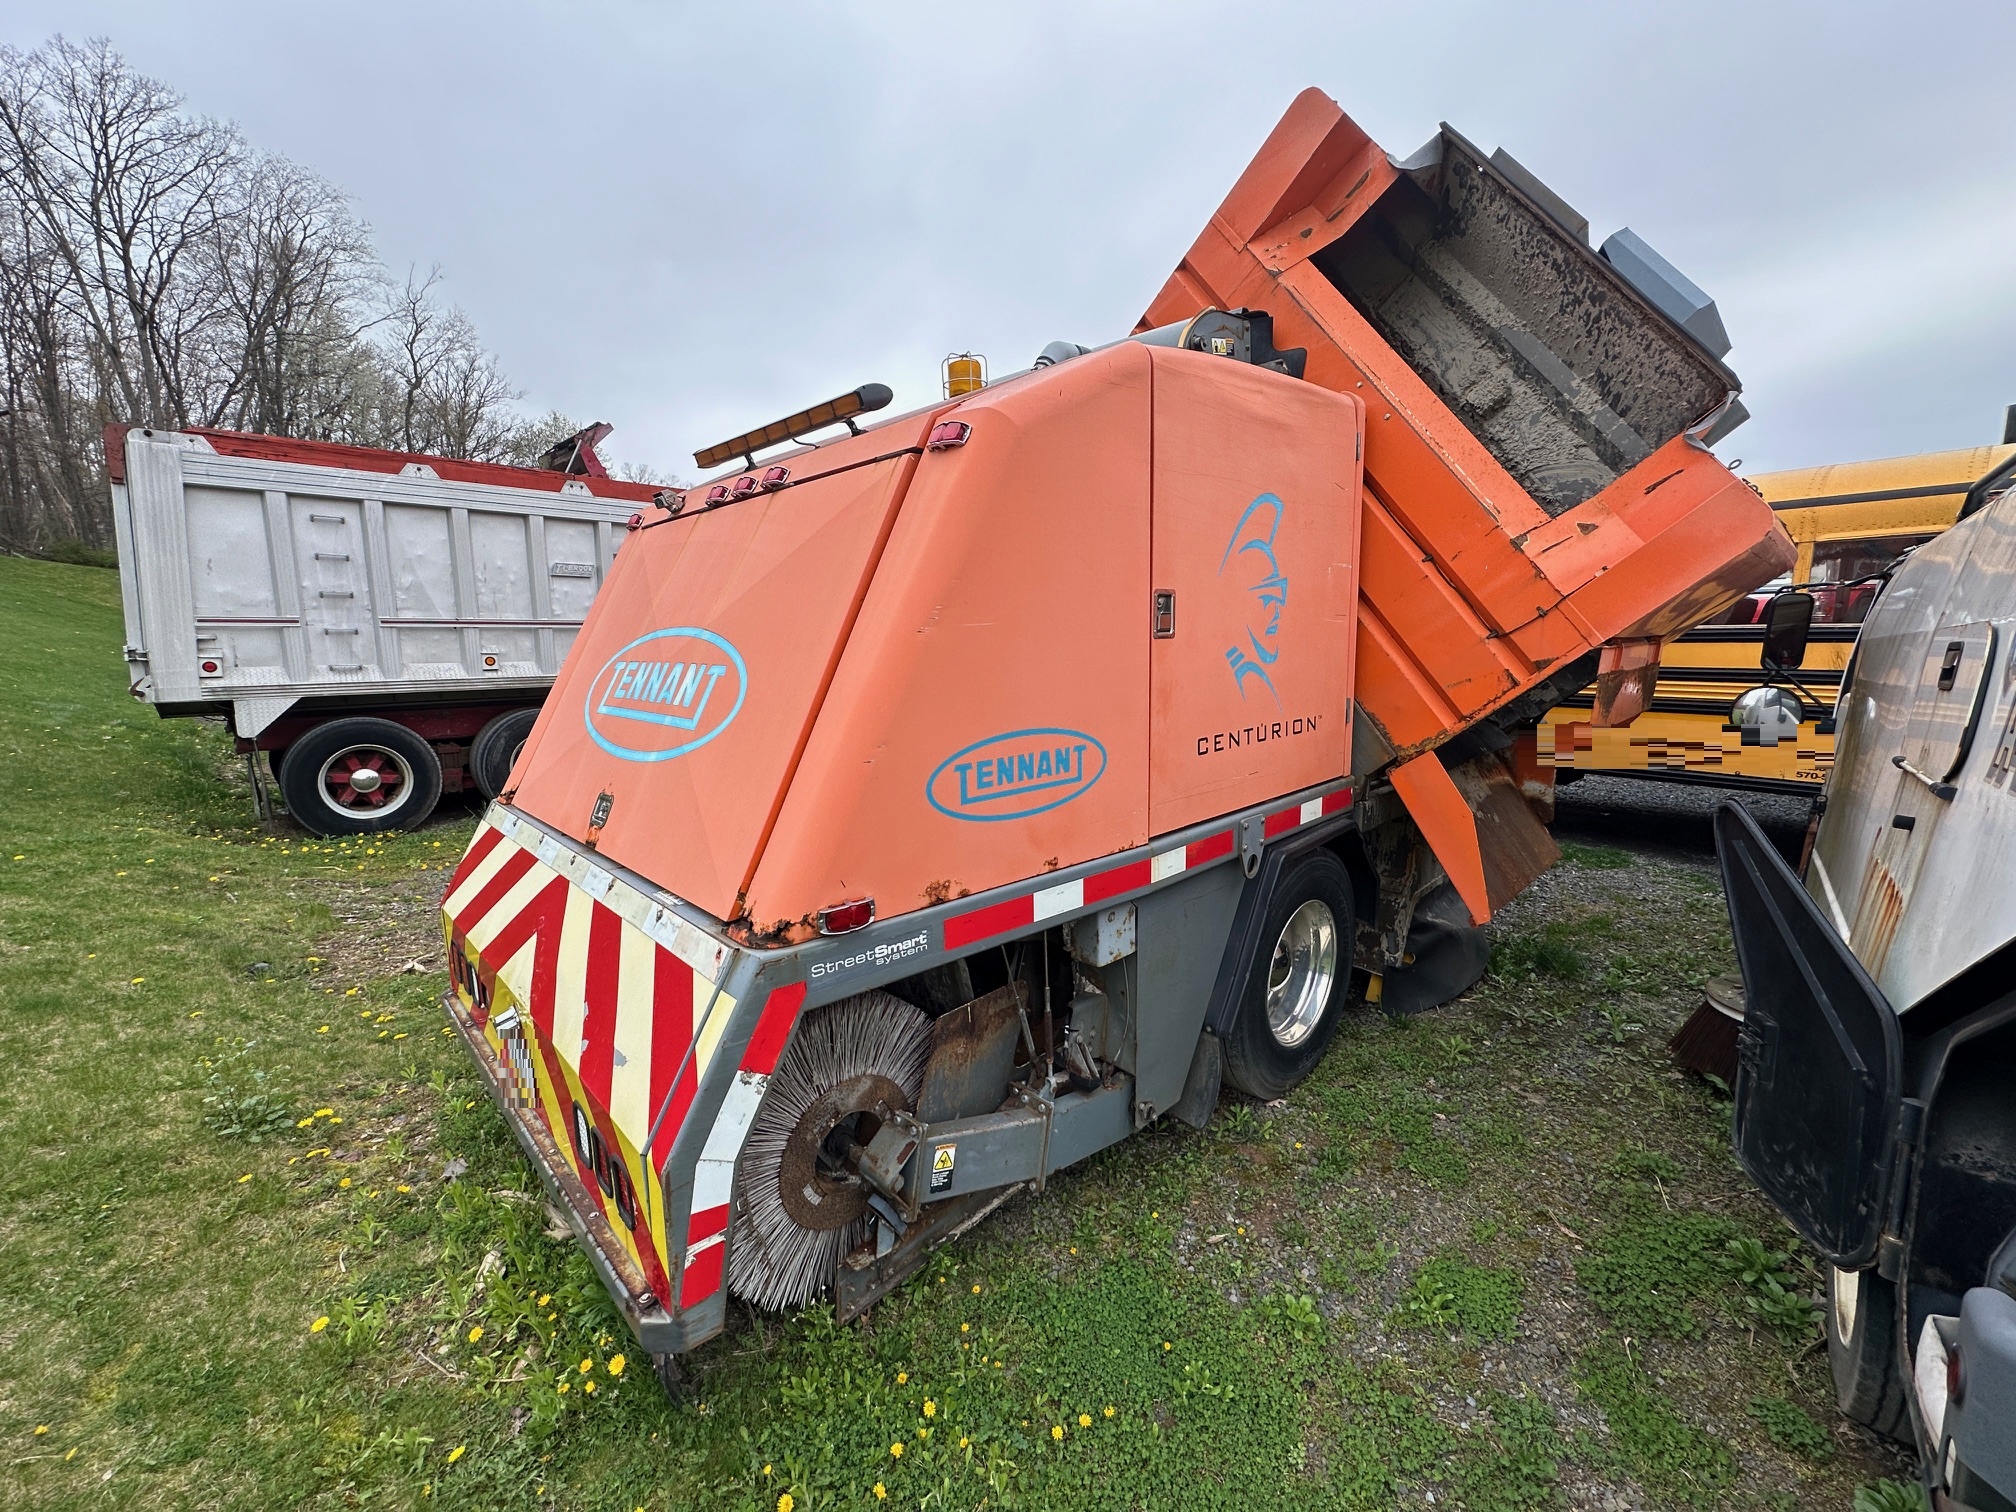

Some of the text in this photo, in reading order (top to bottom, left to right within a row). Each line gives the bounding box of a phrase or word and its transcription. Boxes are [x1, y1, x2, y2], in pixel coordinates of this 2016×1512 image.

[597, 661, 727, 731] TENNANT
[953, 744, 1087, 806] TENNANT
[876, 944, 928, 966] system
